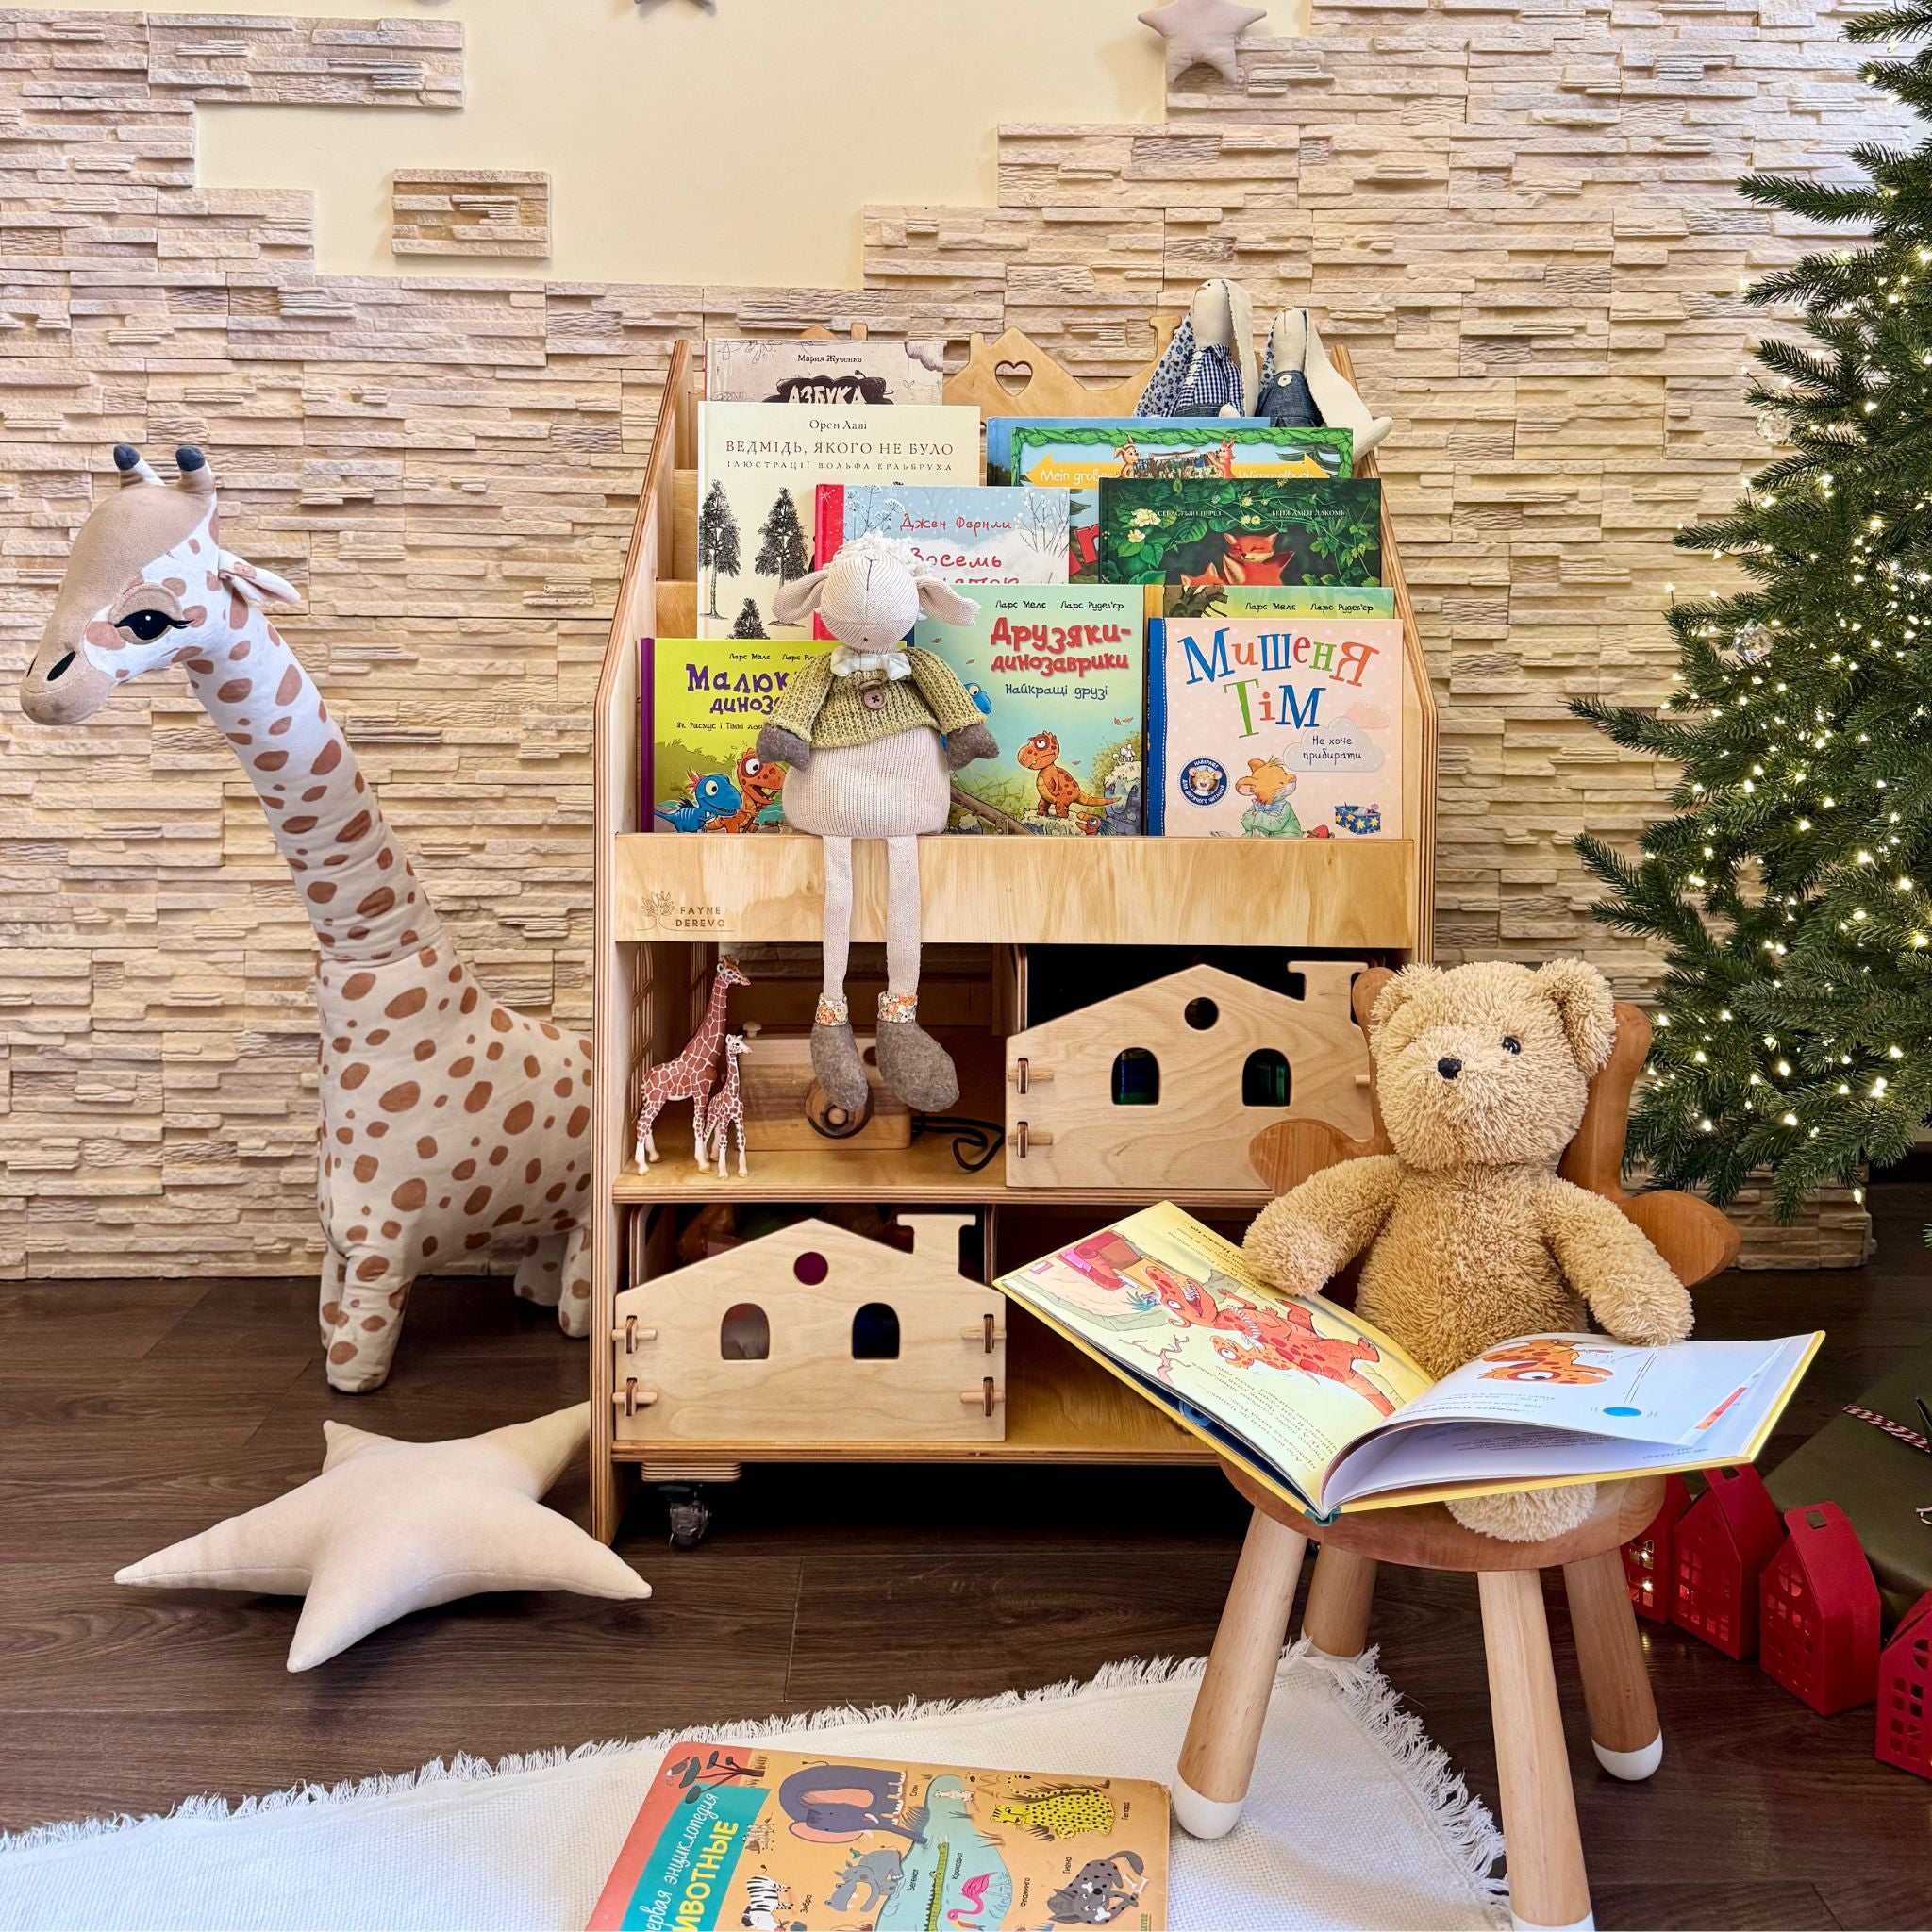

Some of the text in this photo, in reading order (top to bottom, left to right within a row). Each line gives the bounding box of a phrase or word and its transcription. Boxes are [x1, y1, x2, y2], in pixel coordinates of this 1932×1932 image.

[797, 354, 862, 365] Мария Жученко
[788, 385, 868, 404] АЗБУКА
[809, 419, 867, 435] Орен Лаві
[725, 441, 953, 456] ВЕДМІДЬ, ЯКОГО НЕ БУЛО
[727, 460, 810, 472] ІЛЮСТРАЦІЇ
[818, 461, 870, 471] ВОЛЬФА
[1041, 470, 1069, 482] Mein
[900, 513, 1011, 537] Джен Фернли
[1060, 601, 1084, 609] Ларс
[1245, 602, 1268, 610] Ларс
[1310, 603, 1334, 611] Ларс
[991, 617, 1132, 654] Друзяки-
[729, 653, 747, 661] Ларс
[782, 654, 800, 662] Ларс
[991, 653, 1129, 677] динозаврики
[1177, 627, 1380, 687] Мишеня
[686, 663, 798, 693] Малюк
[1006, 683, 1108, 701] Найкращі друзі
[709, 695, 780, 715] диноз
[690, 723, 716, 732] Расмус
[1312, 735, 1352, 745] Не хоче
[1303, 751, 1361, 765] прибирати
[680, 906, 722, 916] FAYNE
[675, 918, 725, 928] DEREVO
[909, 1784, 918, 1797] Слон
[1121, 1801, 1131, 1821] Гепард
[663, 1792, 720, 1885] энциклопедия
[951, 1852, 963, 1880] Крокодил
[1062, 1857, 1073, 1874] Гиена
[671, 1821, 740, 1932] ИВОТНЫЕ
[907, 1869, 919, 1891] Бегемот
[1020, 1877, 1031, 1908] Фламинго
[800, 1894, 813, 1914] Зебра
